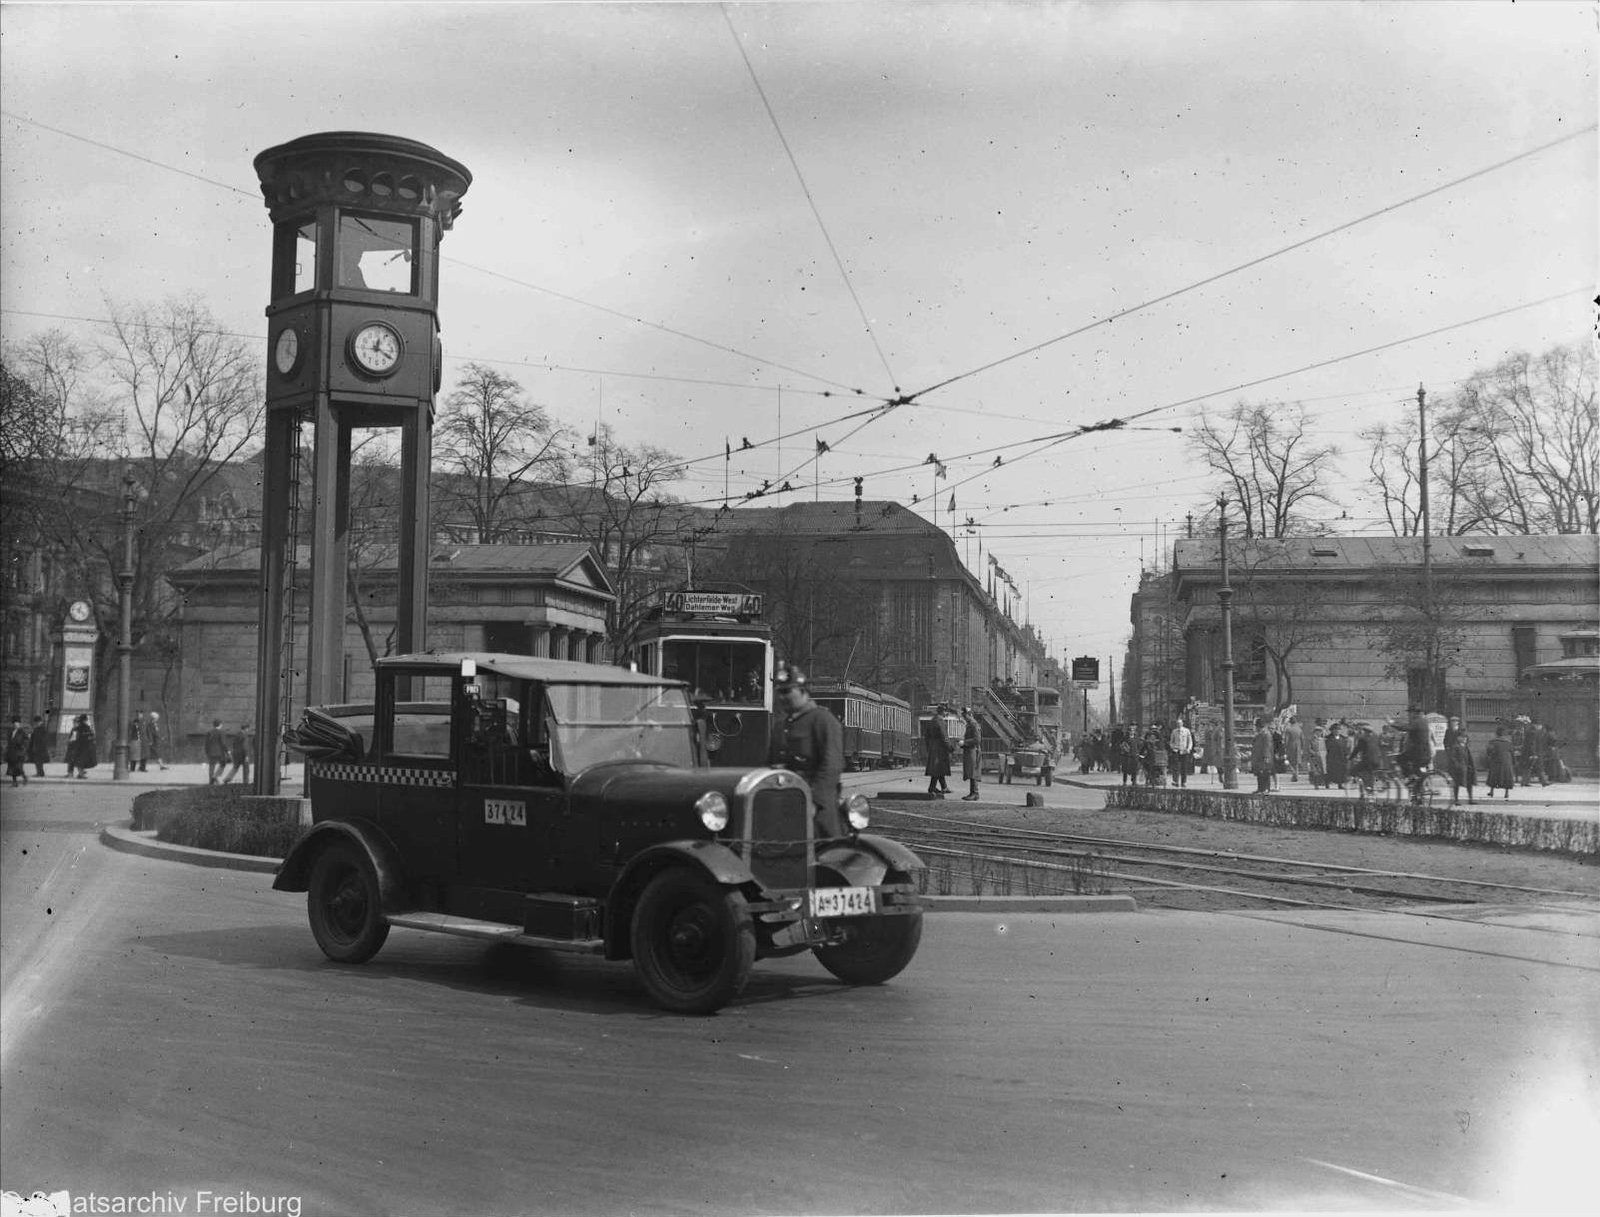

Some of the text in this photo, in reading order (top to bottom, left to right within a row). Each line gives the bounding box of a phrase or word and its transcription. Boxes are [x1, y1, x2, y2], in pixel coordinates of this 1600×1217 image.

[666, 593, 683, 611] 40
[743, 596, 761, 613] 40
[487, 803, 523, 821] 37424
